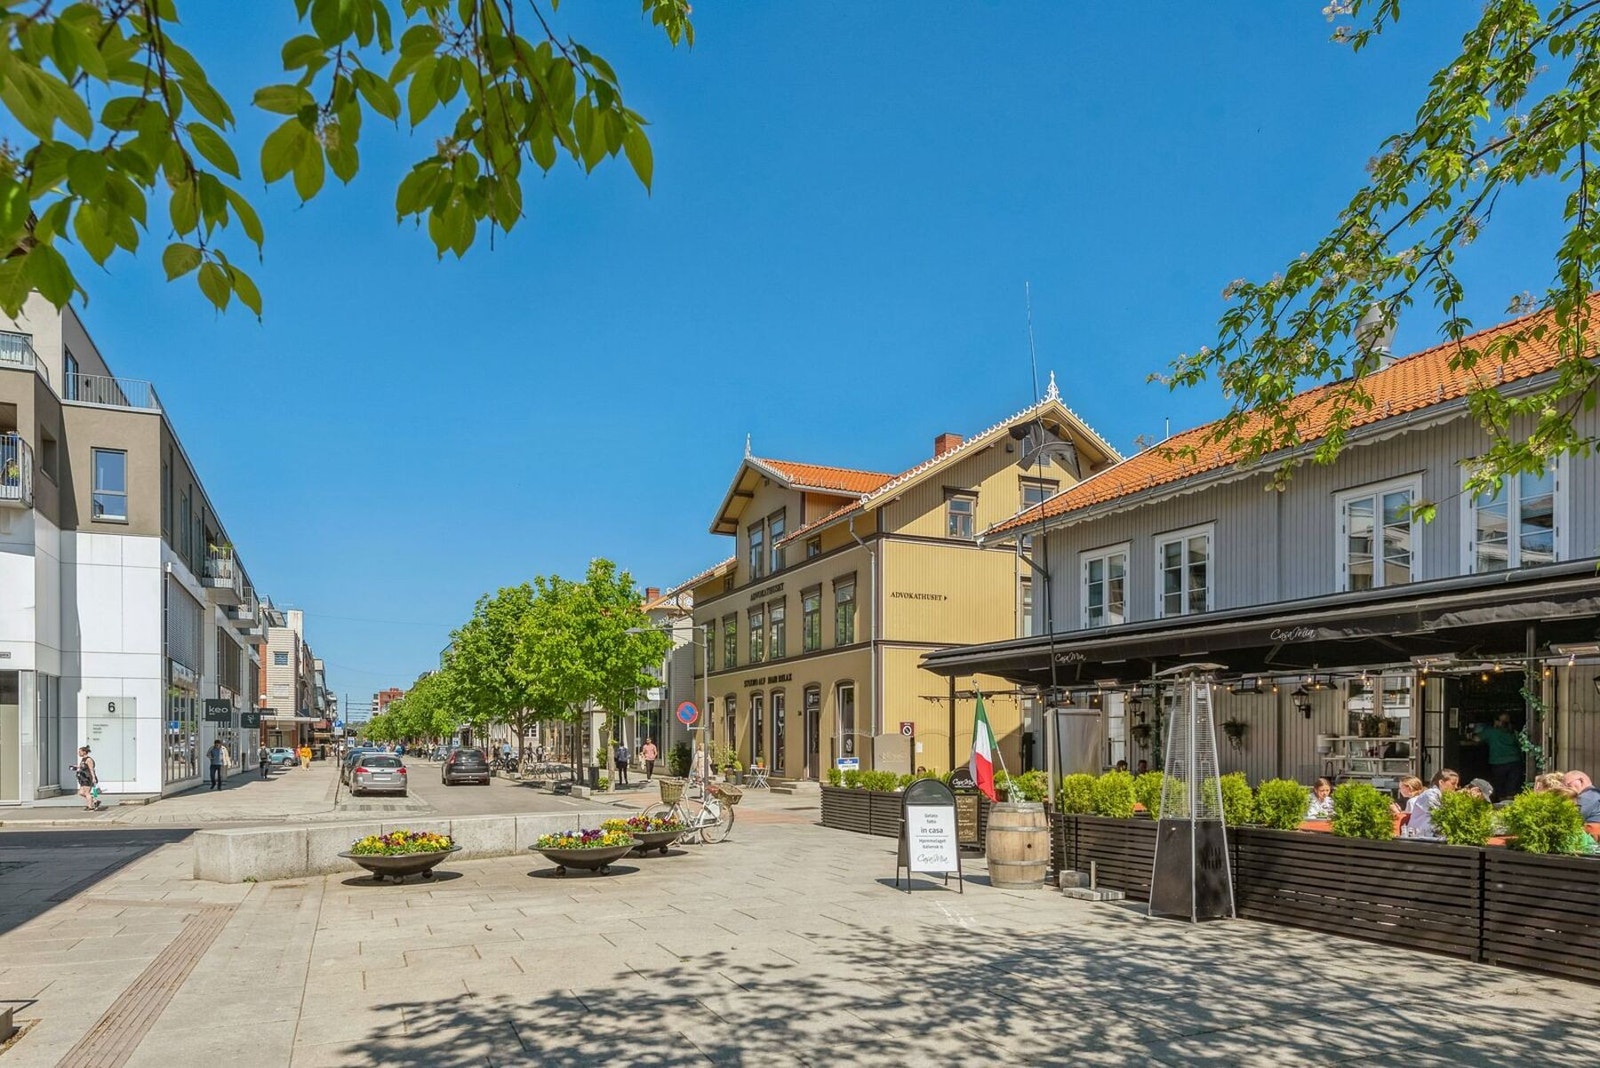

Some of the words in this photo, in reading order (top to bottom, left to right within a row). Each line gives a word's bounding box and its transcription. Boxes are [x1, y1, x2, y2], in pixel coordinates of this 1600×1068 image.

[890, 591, 943, 601] ADVOKATHUSET
[108, 701, 116, 713] 6
[208, 705, 229, 713] keo
